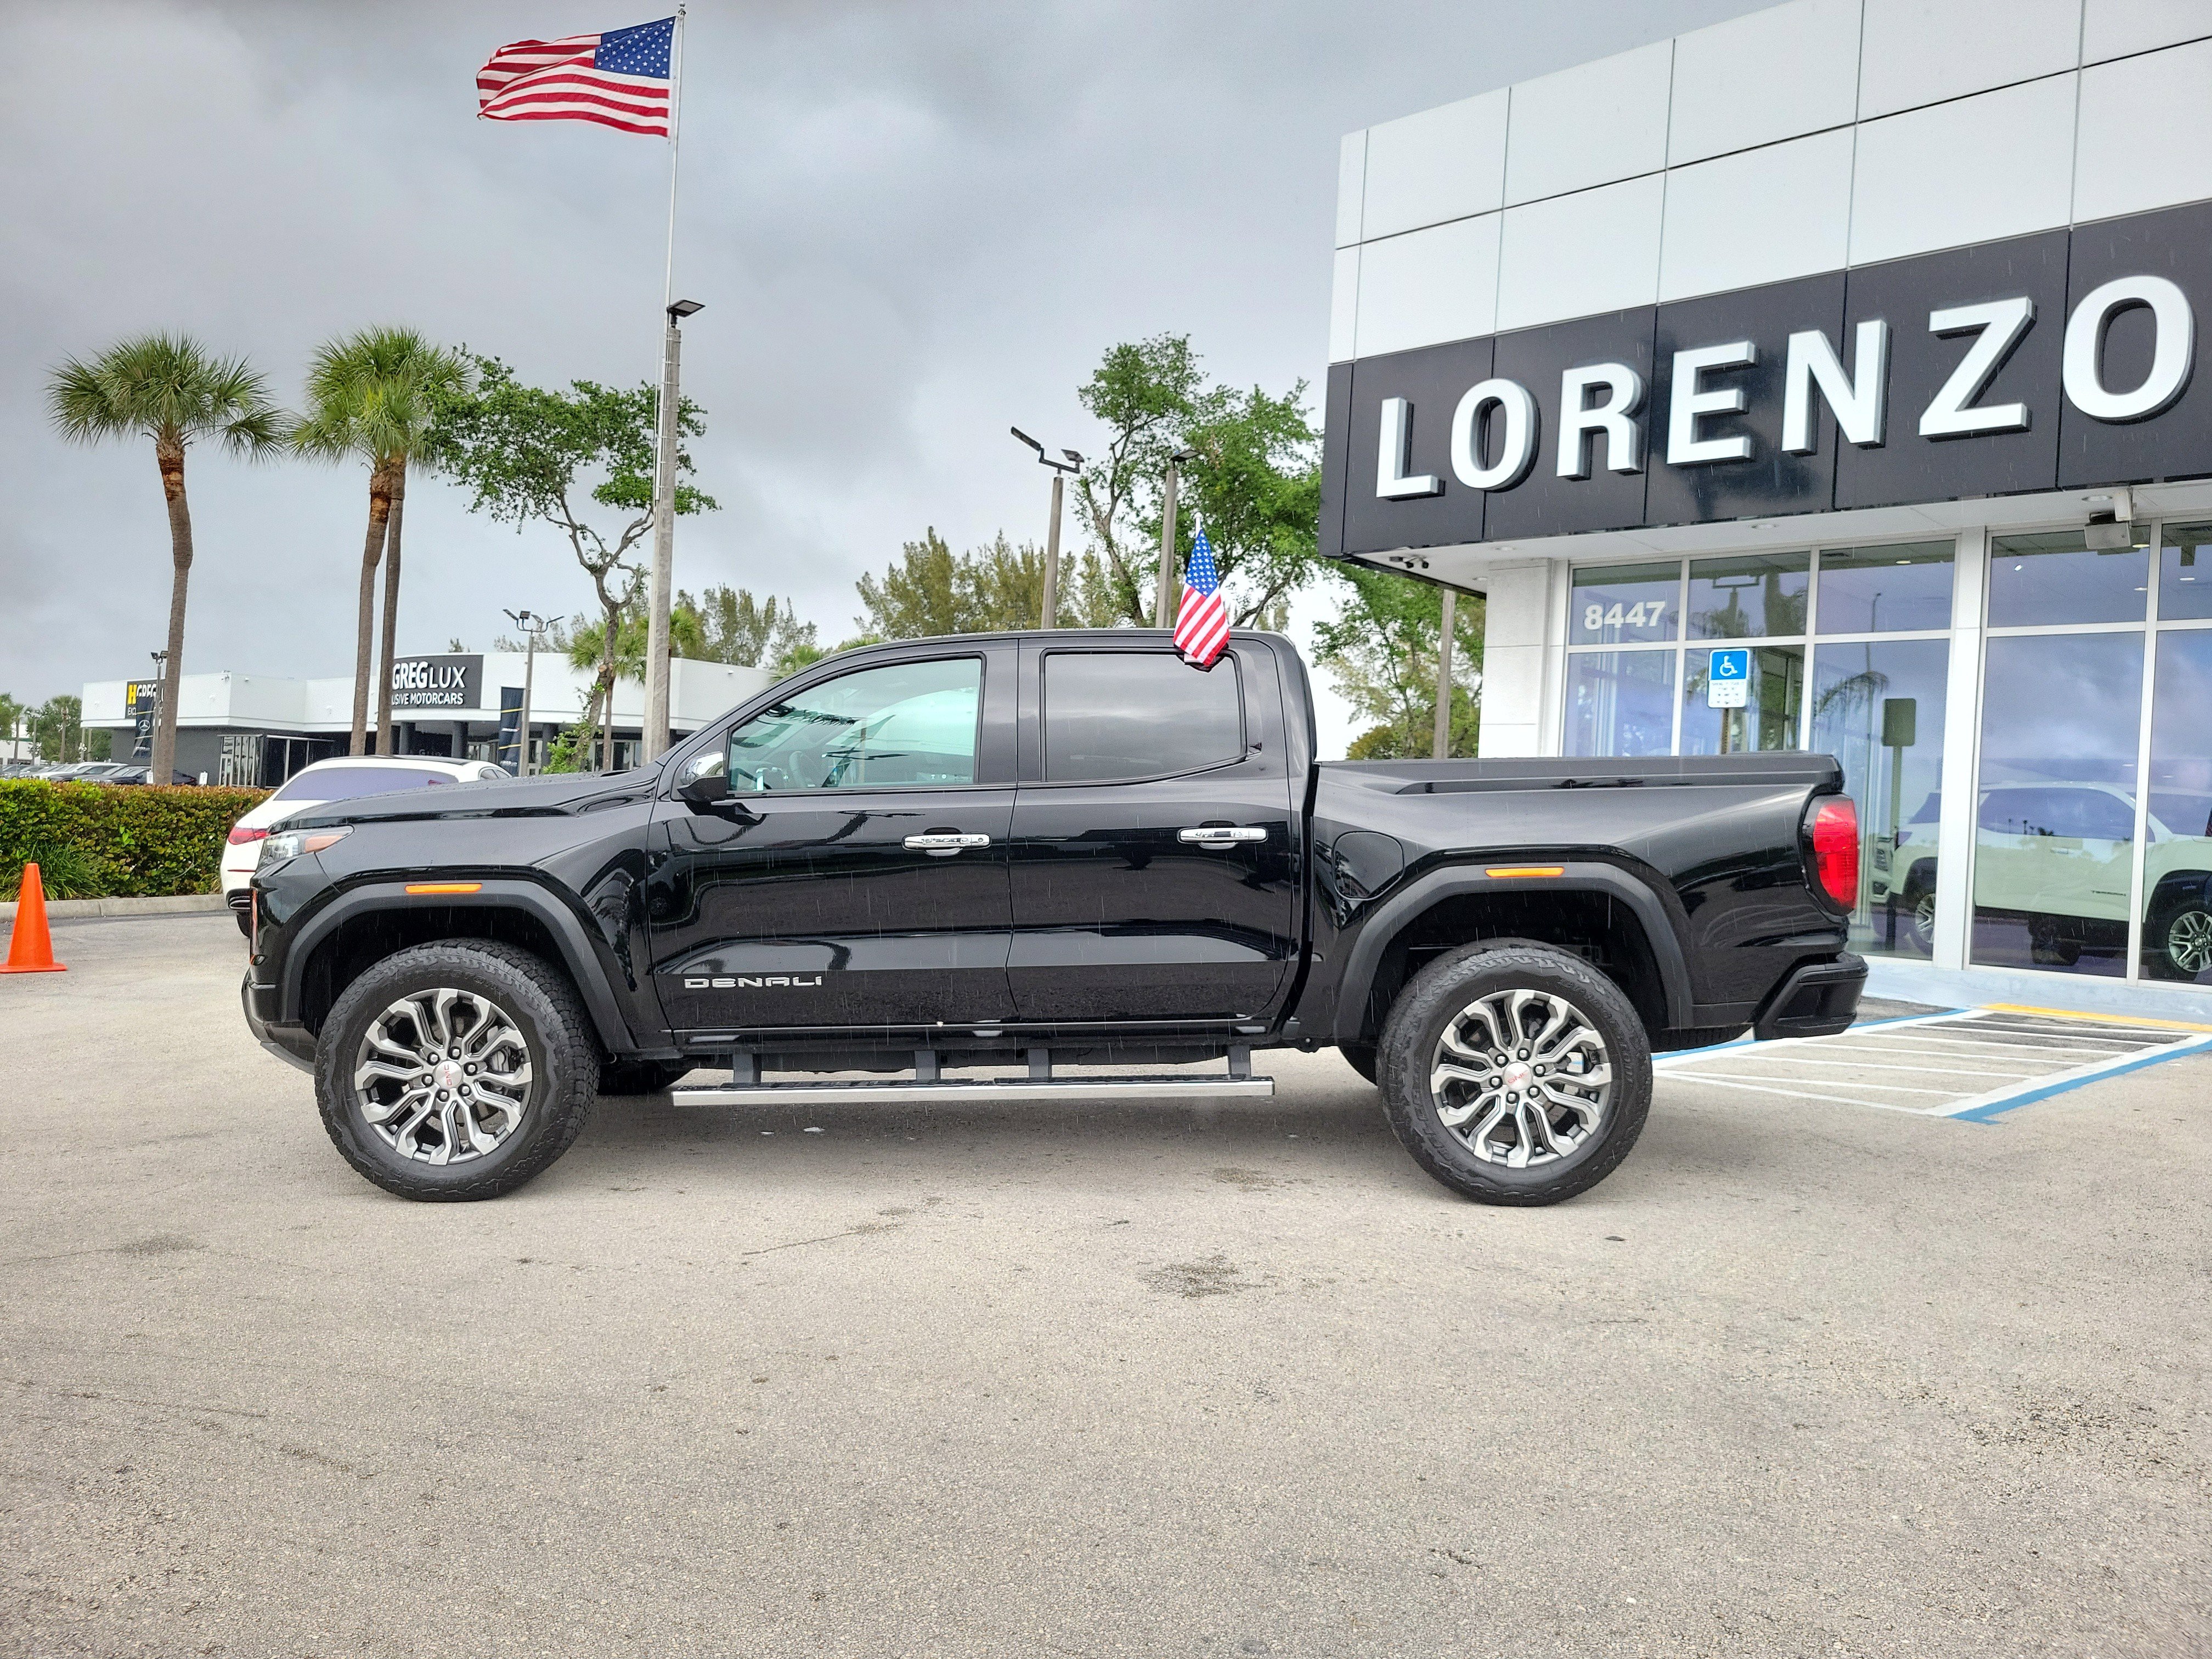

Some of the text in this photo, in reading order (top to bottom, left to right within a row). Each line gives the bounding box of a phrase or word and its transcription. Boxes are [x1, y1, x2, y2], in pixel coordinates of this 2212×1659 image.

[1375, 275, 2194, 500] LORENZO
[1584, 600, 1666, 630] 8447
[392, 661, 466, 690] GREGLUX
[391, 692, 464, 705] USIVE MOTORCARS
[684, 976, 822, 989] DENALI
[444, 1064, 452, 1086] GMC
